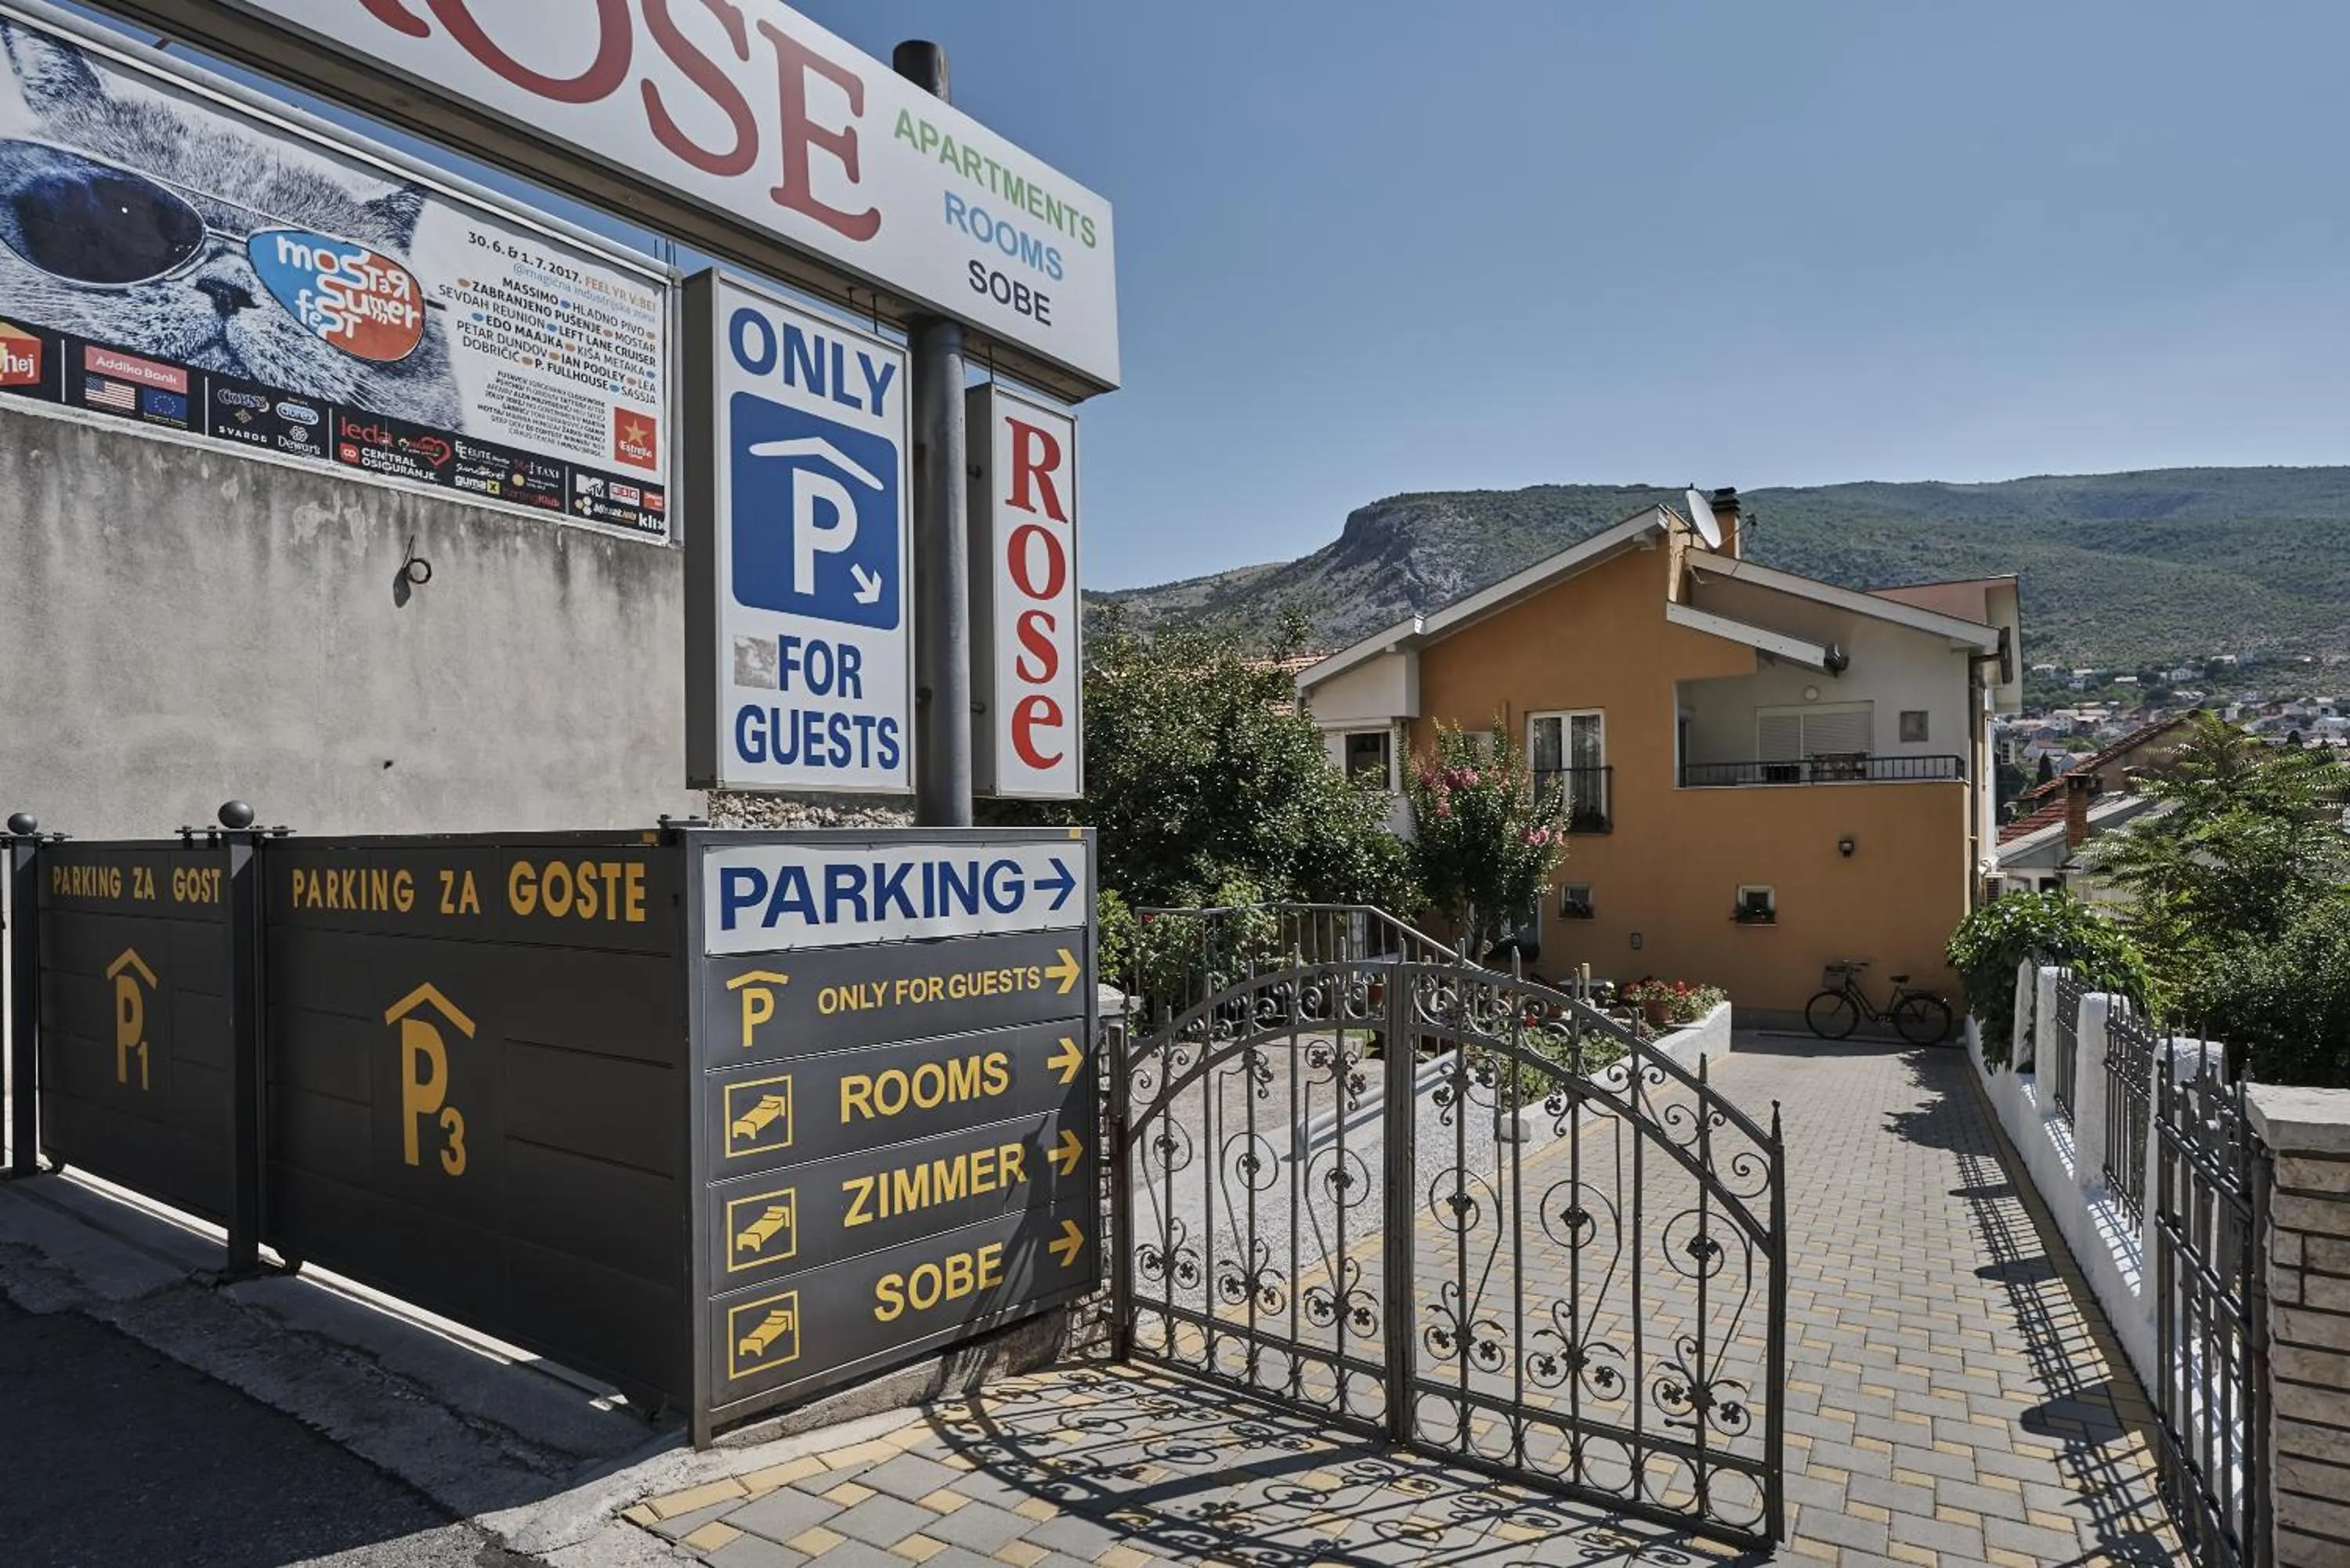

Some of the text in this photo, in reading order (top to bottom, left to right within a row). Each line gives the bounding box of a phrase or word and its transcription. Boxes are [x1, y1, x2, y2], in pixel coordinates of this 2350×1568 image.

[894, 107, 1096, 249] APARTMENTS
[945, 190, 1063, 282] ROOMS
[439, 284, 655, 367] SEVDAH REUNION LEFT LANE CRUISER
[472, 280, 655, 354] ZABRANJENO PUŠENJE MOSTAR
[502, 276, 644, 336] MASSIMO HLADNO PIVO
[968, 259, 1051, 327] SOBE
[3, 348, 34, 379] hej
[96, 356, 177, 384] Addiko Bank
[457, 320, 494, 341] PETAR
[497, 332, 547, 358] DUNDOV
[562, 353, 580, 368] IAN
[584, 360, 625, 383] POOLEY
[638, 378, 655, 392] LEA
[486, 314, 644, 376] EDO MAAJKA KIŠA METAKA
[729, 308, 896, 417] ONLY
[535, 358, 544, 370] P.
[548, 361, 608, 390] FULLHOUSE
[621, 385, 655, 405] SASSJA
[340, 417, 393, 447] leda
[361, 447, 417, 468] CENTRAL
[361, 457, 436, 480] OSIGURANJE
[536, 465, 559, 479] TAXI
[793, 468, 858, 595] P
[779, 634, 862, 699] FOR
[735, 704, 900, 770] GUESTS
[52, 865, 221, 903] PARKING ZA GOST
[293, 862, 645, 922] PARKING ZA GOSTE
[721, 858, 1025, 930] PARKING
[743, 966, 1040, 1047] P ONLY FOR GUESTS
[841, 1052, 1008, 1122] ROOMS
[841, 1143, 1030, 1227] ZIMMER
[874, 1242, 1003, 1323] SOBE
